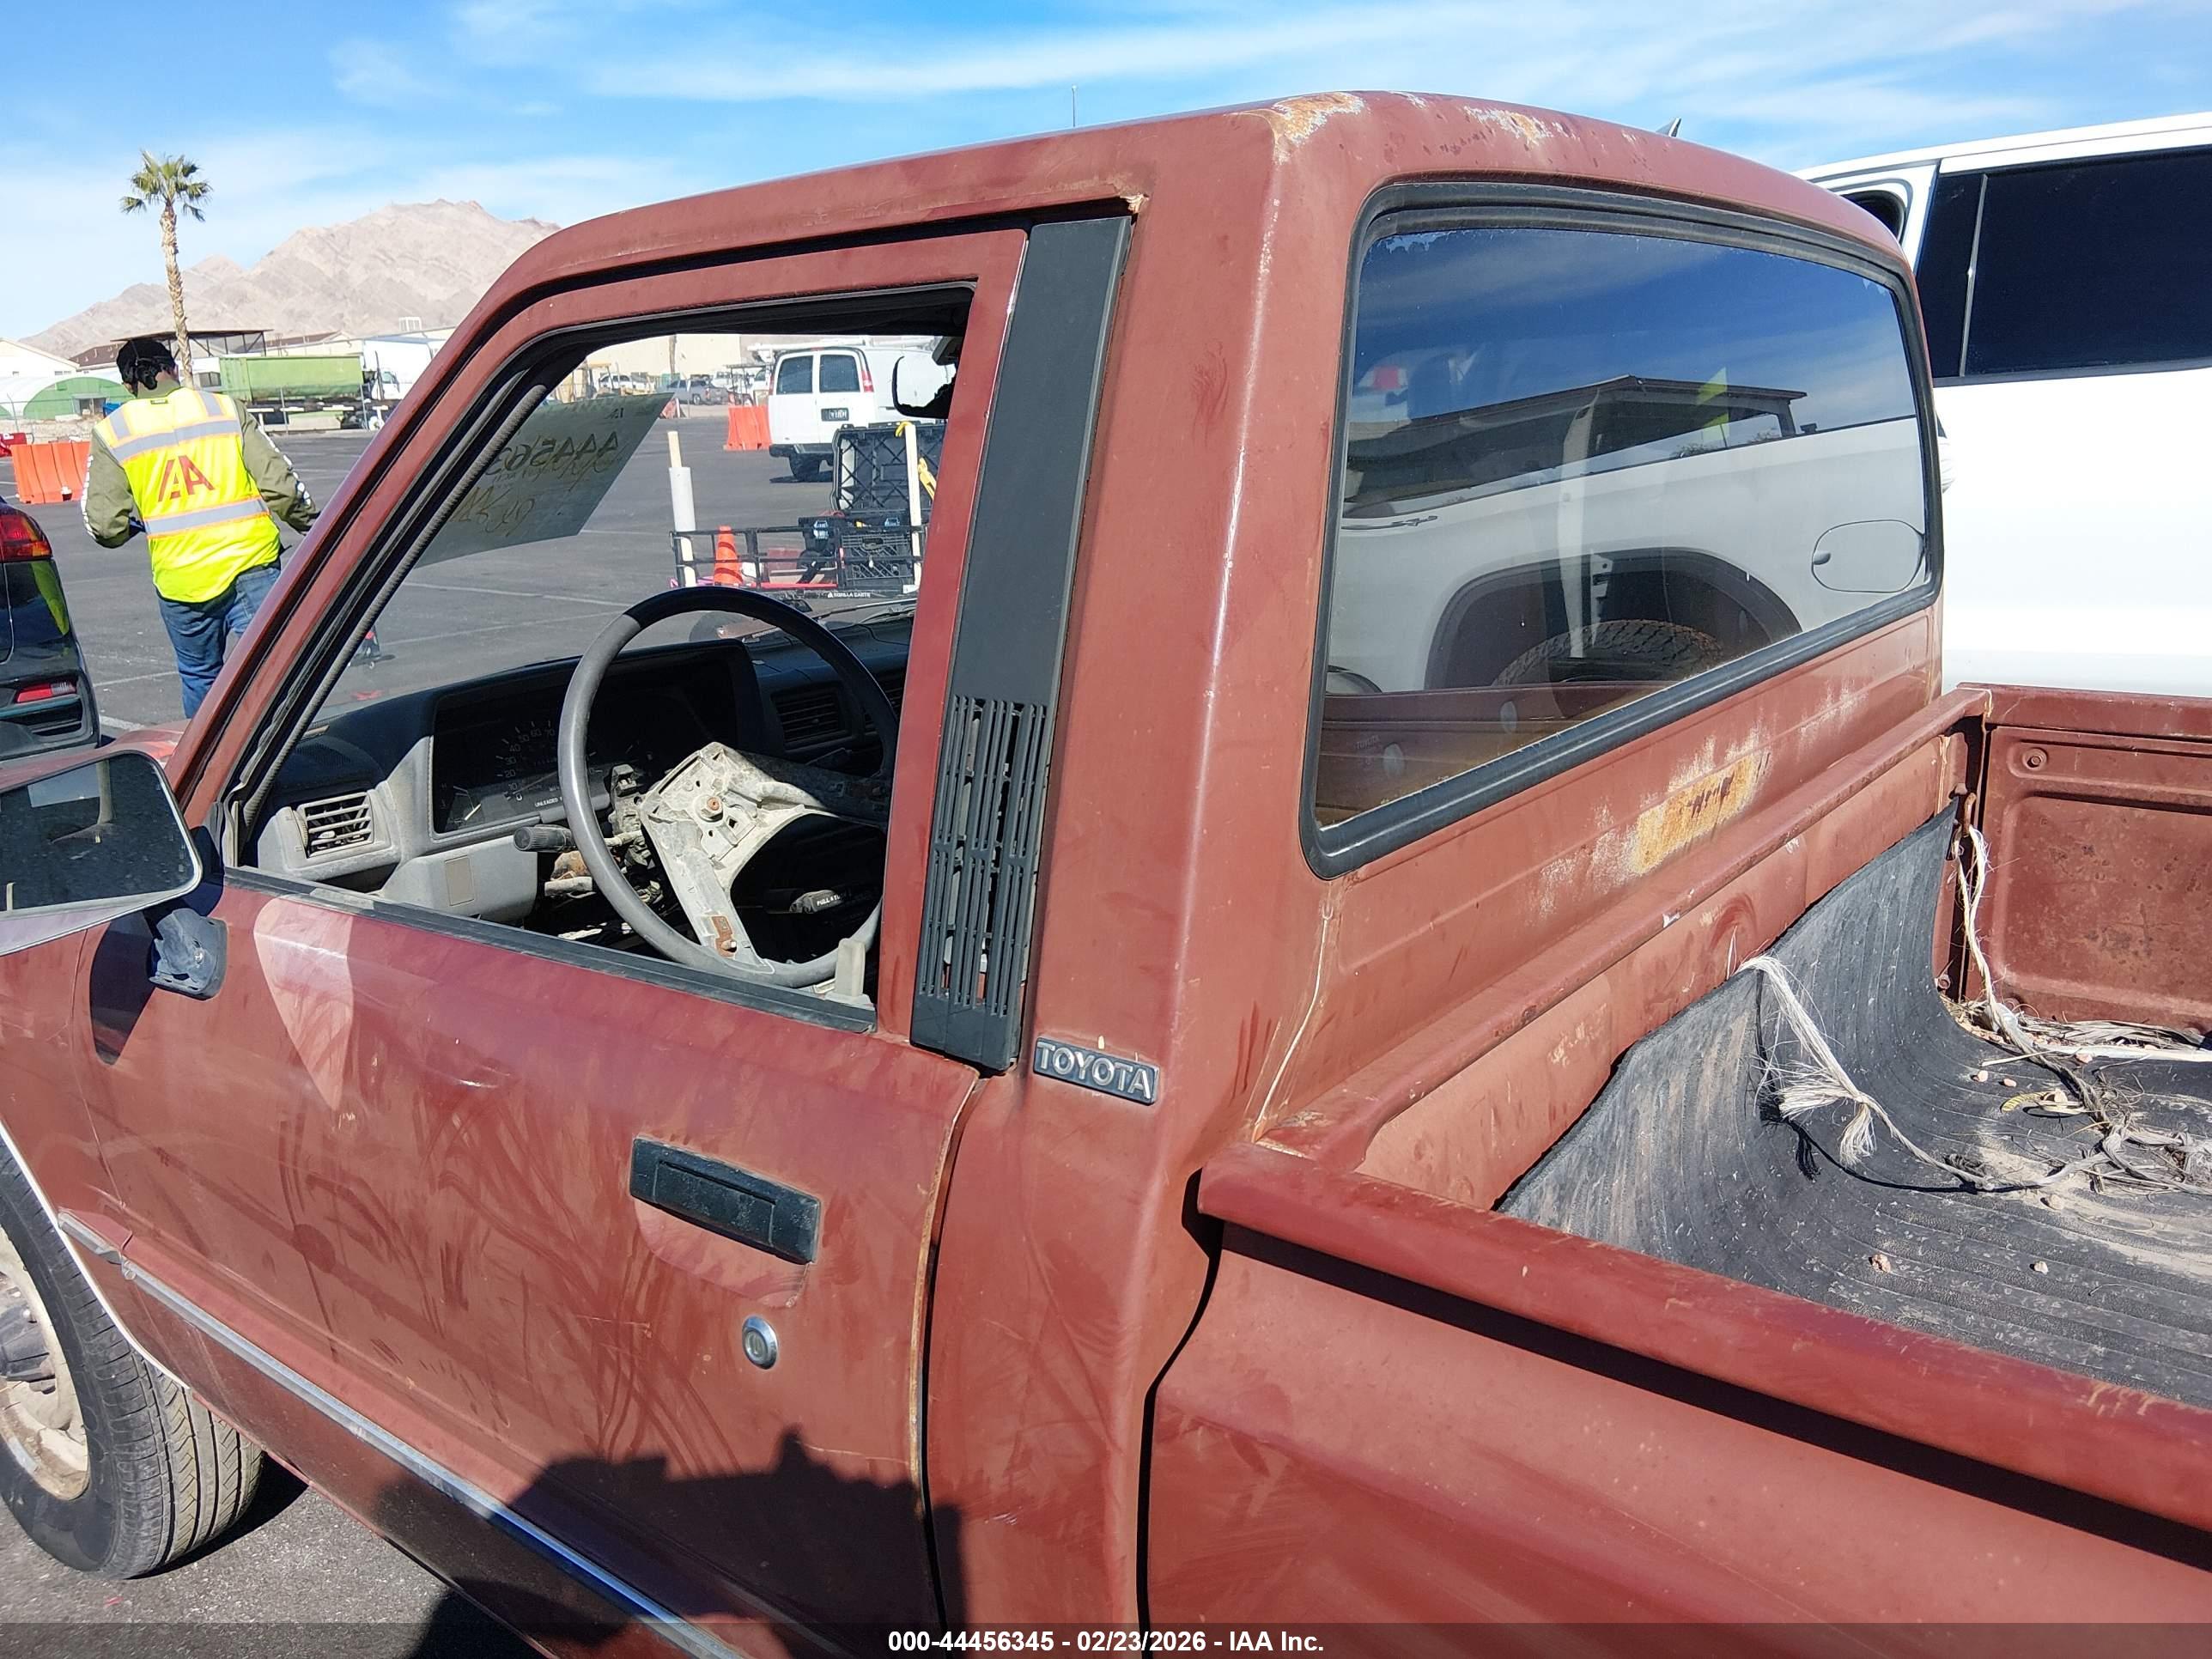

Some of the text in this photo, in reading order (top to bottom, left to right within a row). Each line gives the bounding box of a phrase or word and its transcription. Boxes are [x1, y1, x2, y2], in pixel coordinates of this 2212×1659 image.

[530, 728, 543, 738] 60
[508, 743, 522, 753] 40
[504, 757, 518, 765] 30
[504, 769, 516, 778] 20
[508, 781, 518, 791] 10
[1036, 1041, 1151, 1099] TOYOTA
